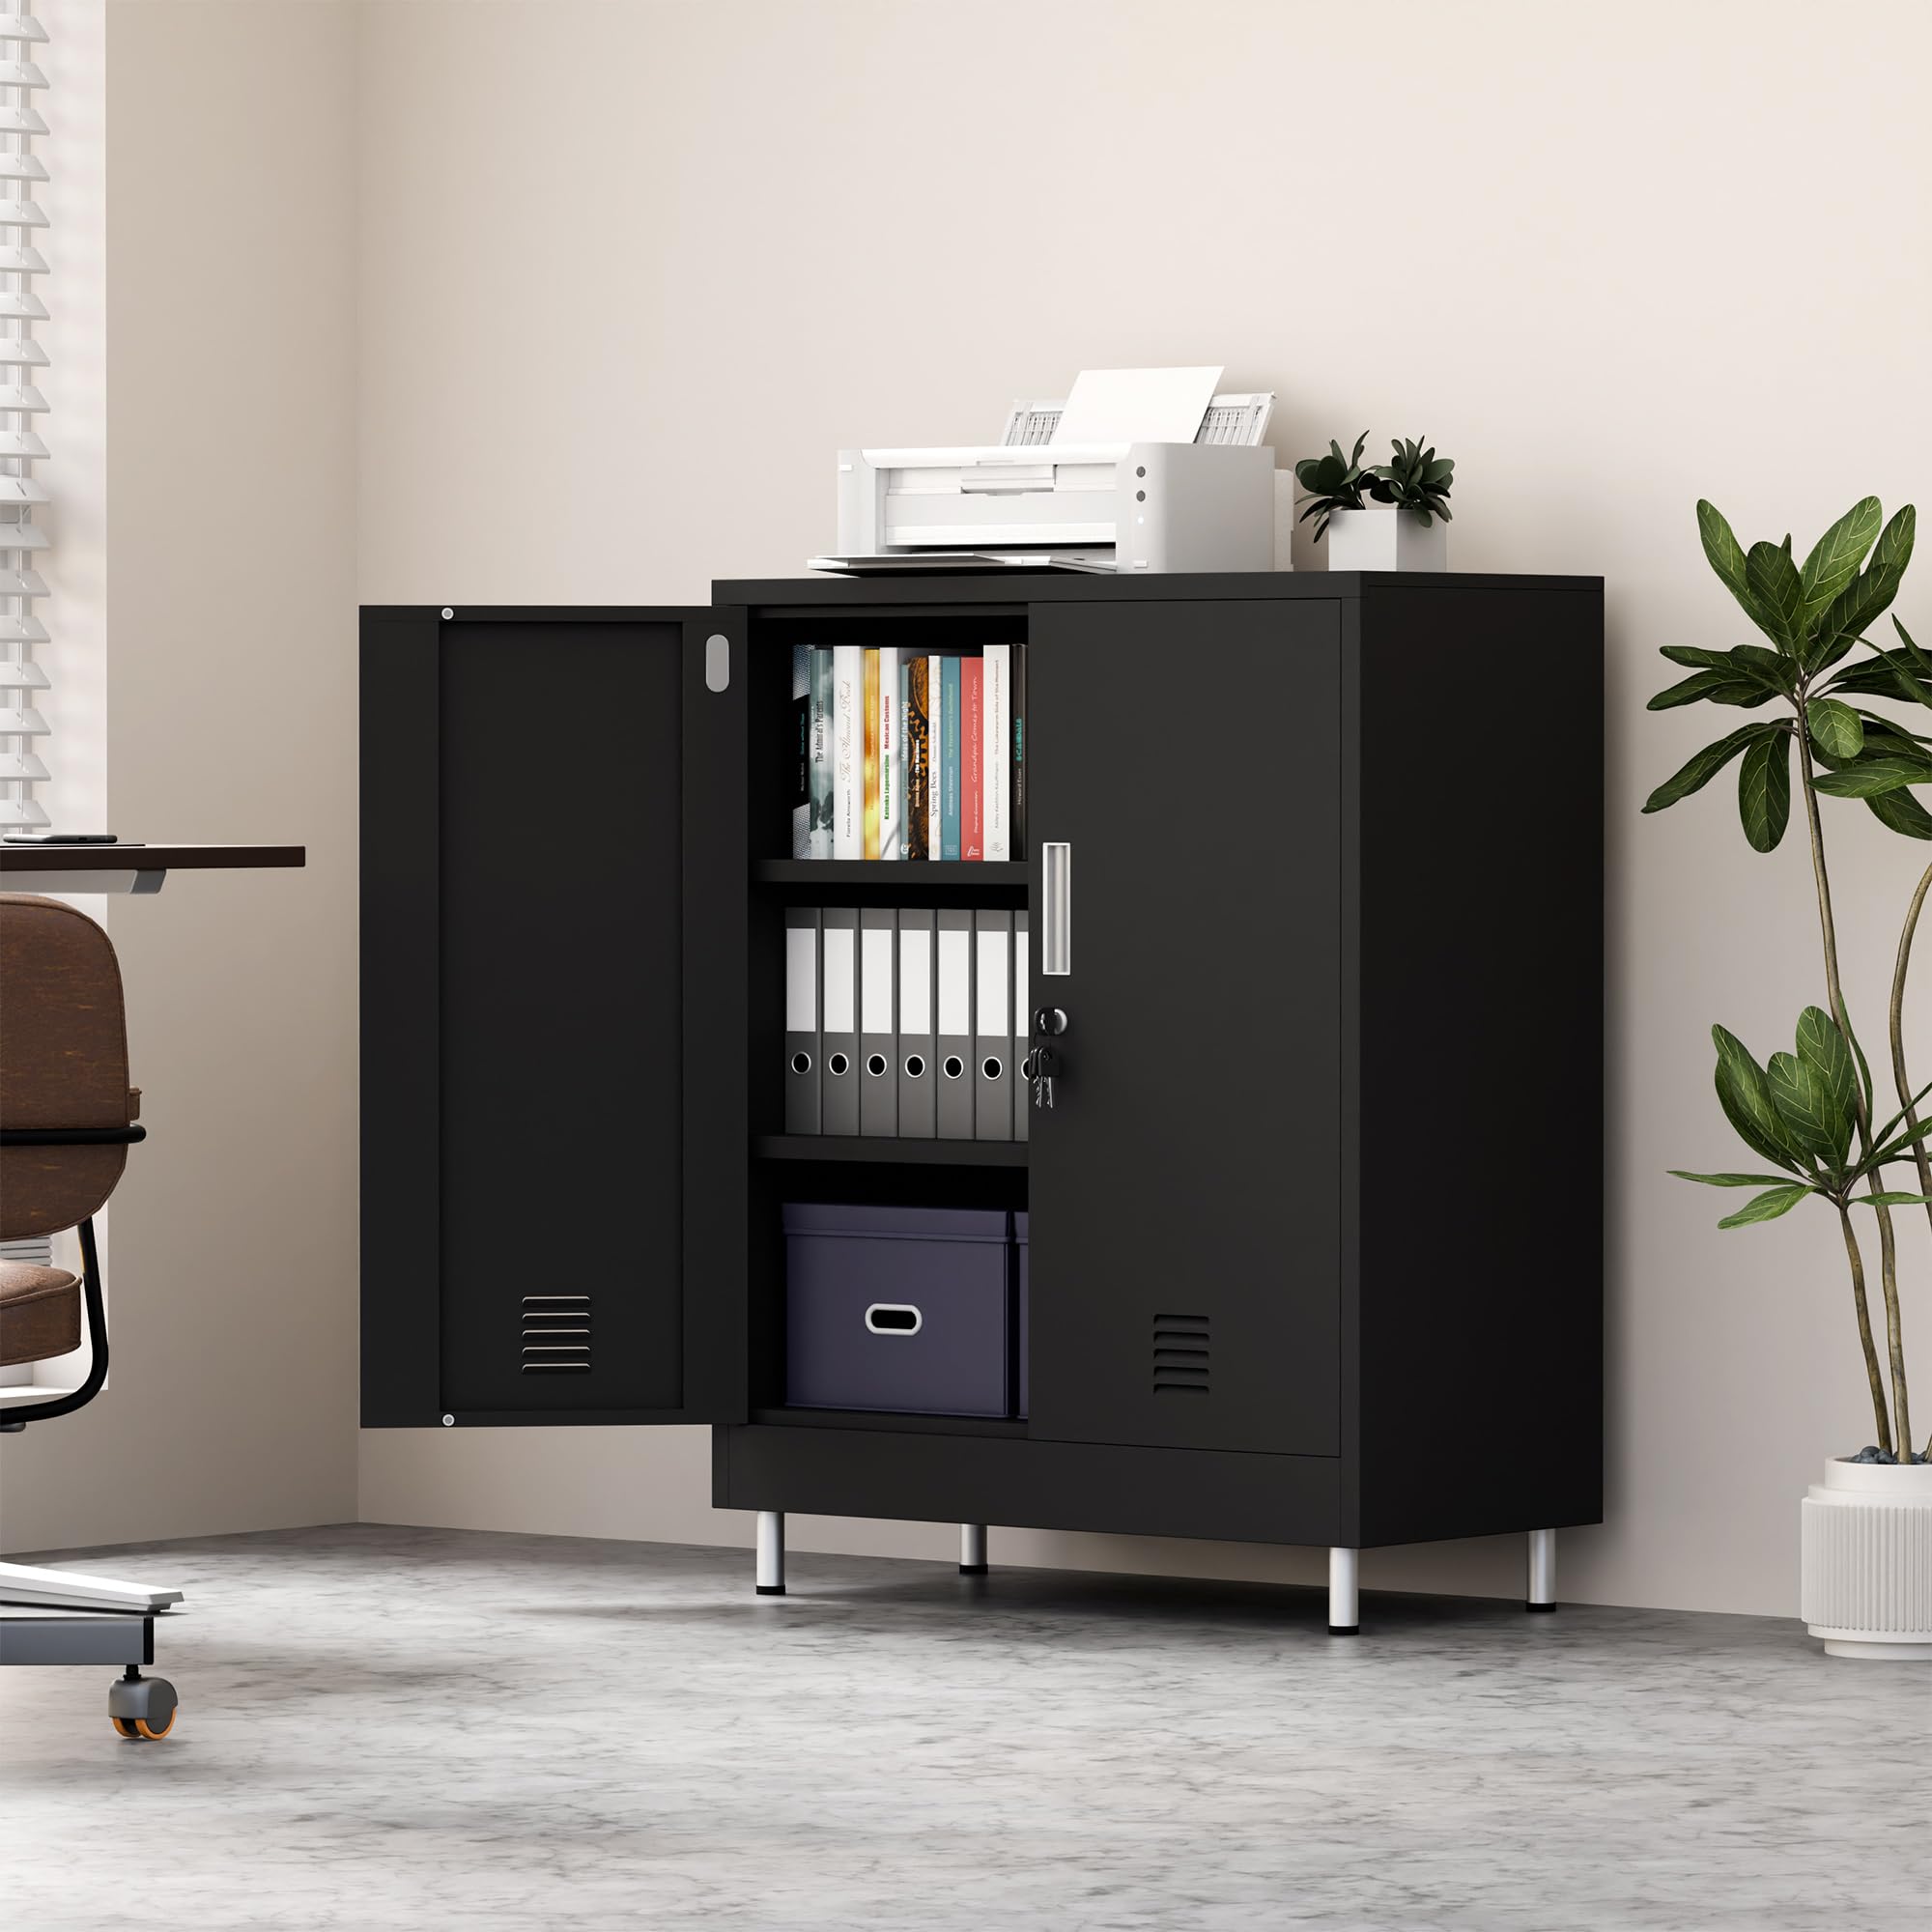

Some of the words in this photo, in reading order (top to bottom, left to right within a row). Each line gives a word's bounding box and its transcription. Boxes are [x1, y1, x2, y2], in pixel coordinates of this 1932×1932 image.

[838, 679, 851, 712] Book
[814, 700, 824, 723] Parents
[814, 724, 824, 751] Admiral's
[838, 713, 851, 759] Almond
[814, 752, 824, 763] The
[970, 742, 979, 782] Grandpa
[838, 761, 851, 783] The
[929, 790, 939, 817] Spring
